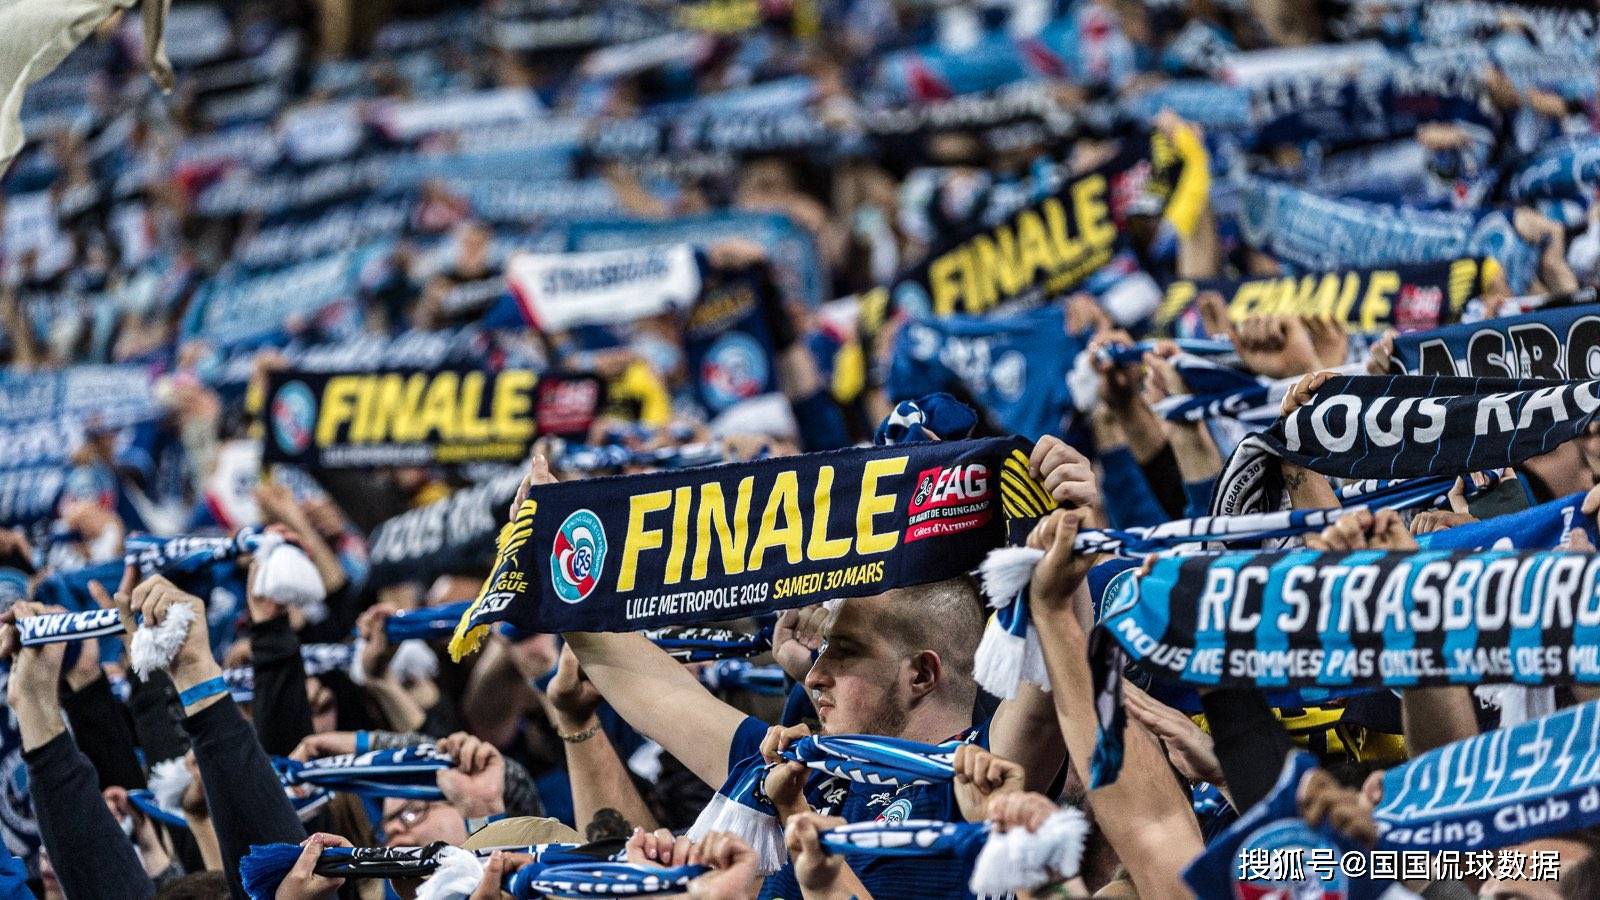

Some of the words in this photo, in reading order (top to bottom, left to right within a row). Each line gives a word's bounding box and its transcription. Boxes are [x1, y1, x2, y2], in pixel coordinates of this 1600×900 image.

[928, 174, 1117, 317] FINALE
[316, 369, 538, 448] FINALE
[1285, 393, 1456, 452] TOUS
[930, 508, 940, 518] DE
[931, 463, 987, 503] EAG
[616, 456, 909, 593] FINALE
[509, 571, 525, 580] DE
[626, 593, 659, 620] LILLE
[658, 586, 738, 617] METROPOLE
[740, 582, 769, 605] 2019
[773, 571, 824, 600] SAMEDI
[824, 569, 843, 589] 30
[842, 560, 884, 587] MARS
[1199, 565, 1270, 632] RC
[1118, 616, 1192, 672] NOUS
[1191, 648, 1224, 675] NE
[1230, 649, 1324, 677] SOMMES
[1327, 647, 1375, 678] PAS
[1516, 646, 1562, 677] DES
[1493, 796, 1571, 833] Club
